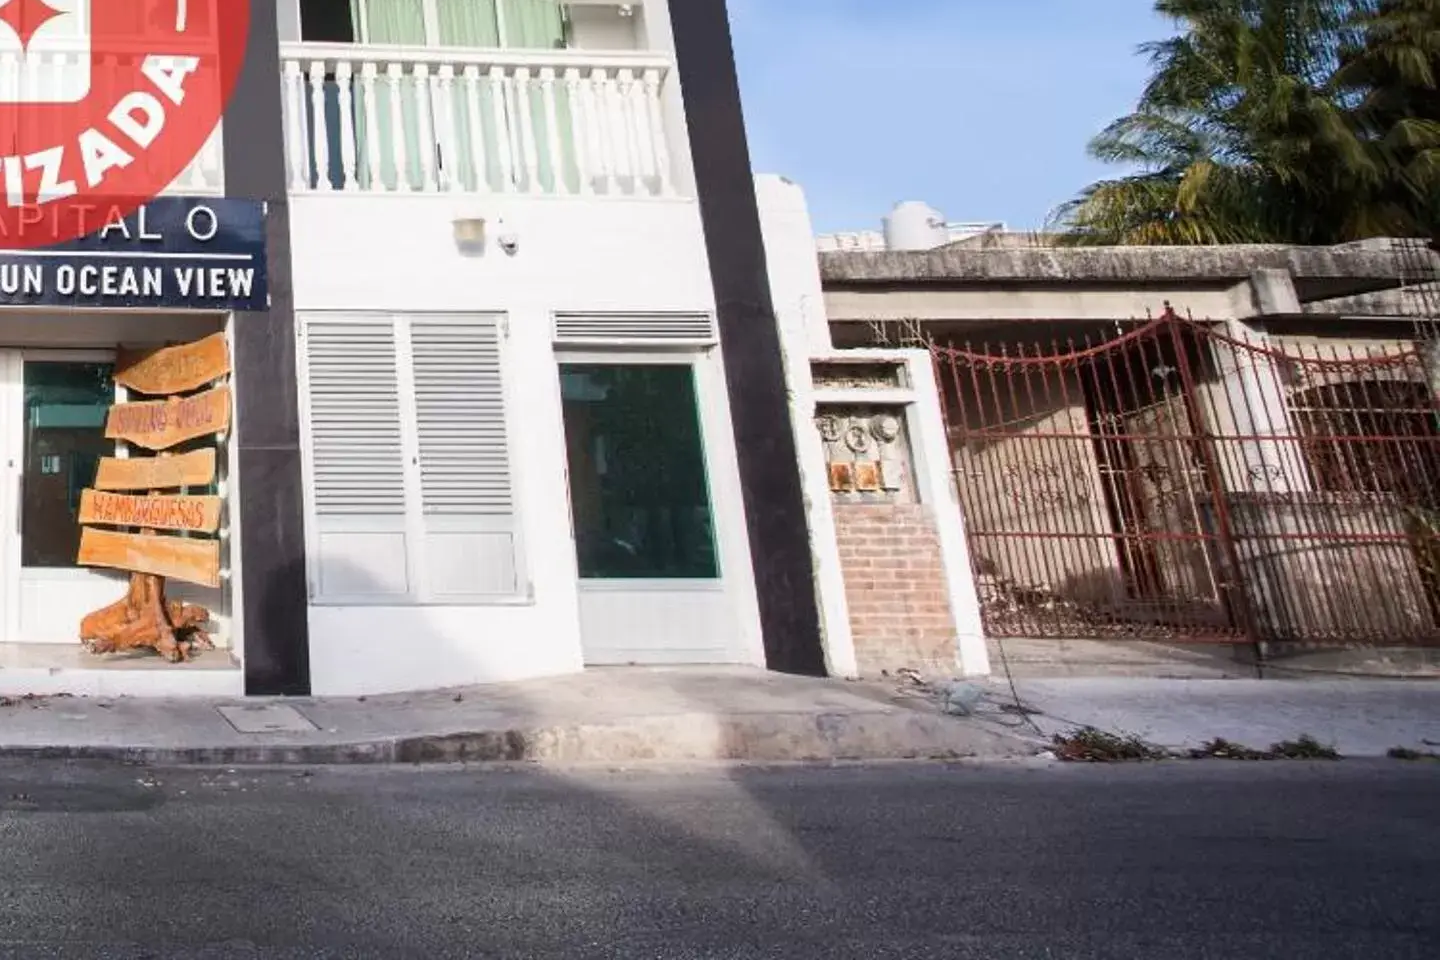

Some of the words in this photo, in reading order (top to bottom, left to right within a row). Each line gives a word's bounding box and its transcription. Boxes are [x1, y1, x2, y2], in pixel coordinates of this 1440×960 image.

[186, 205, 218, 241] O
[56, 264, 162, 296] OCEAN
[173, 267, 255, 297] VIEW
